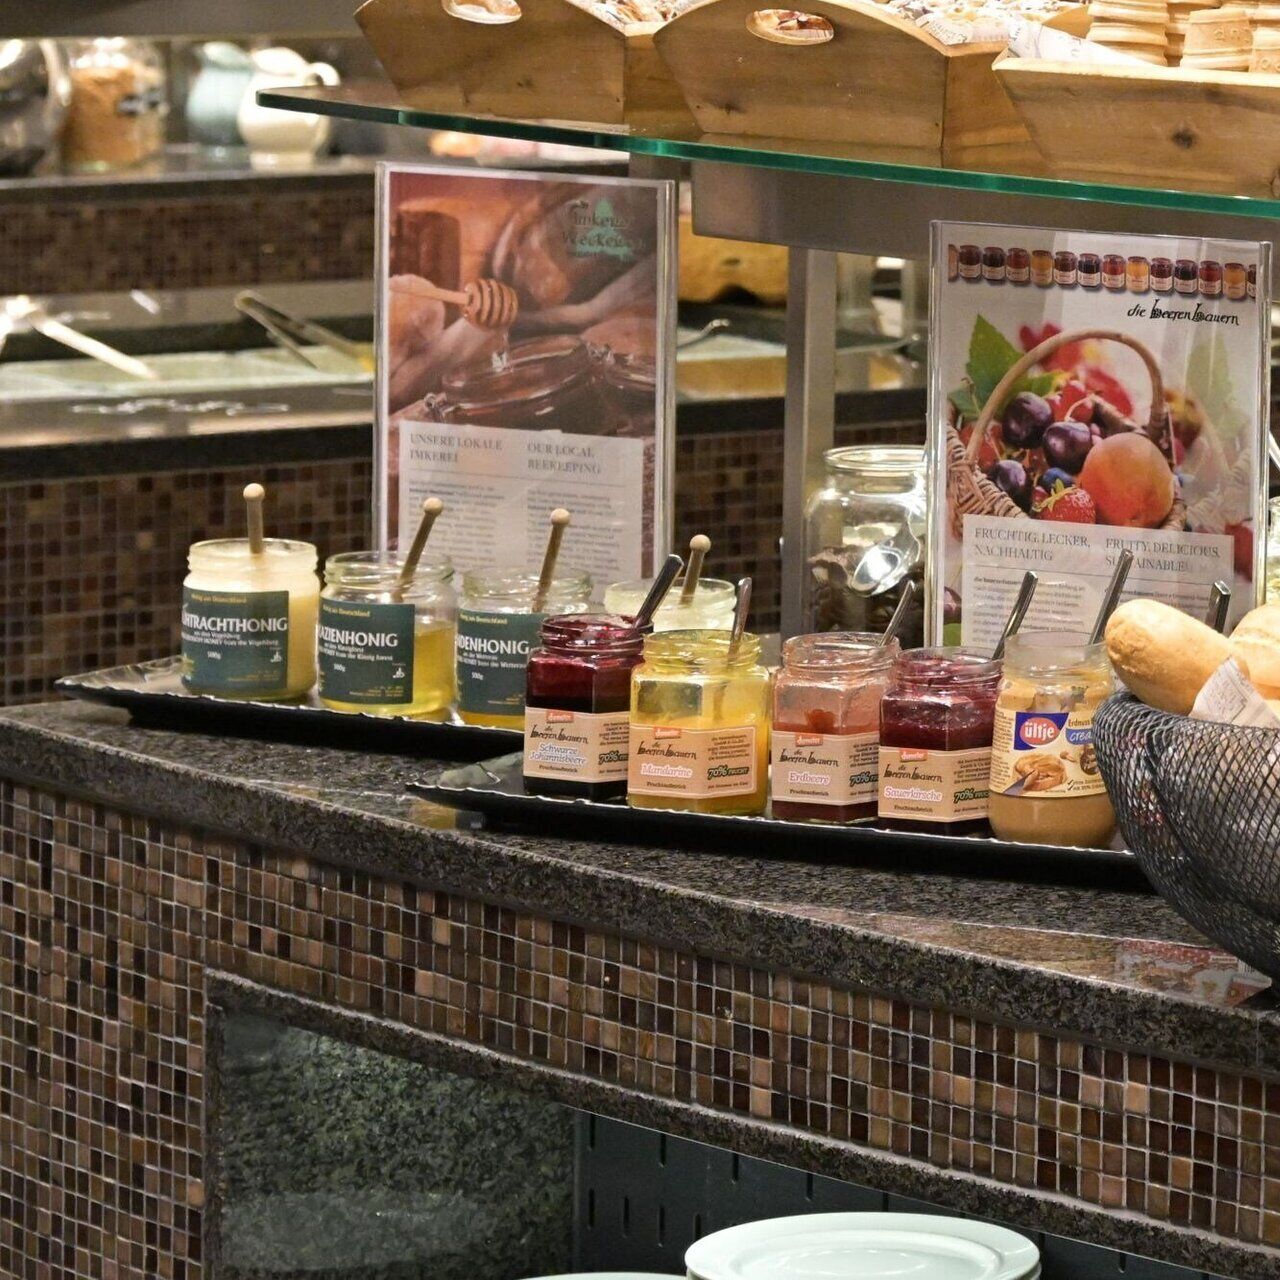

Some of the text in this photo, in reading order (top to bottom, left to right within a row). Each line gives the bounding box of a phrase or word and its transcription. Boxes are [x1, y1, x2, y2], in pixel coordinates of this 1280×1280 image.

[1127, 304, 1146, 317] die
[410, 433, 502, 451] UNSERE LOKALE
[527, 442, 595, 458] OUR LOCAL
[409, 448, 458, 462] IMKEREI
[528, 459, 600, 474] BEEKEEPING
[1042, 532, 1090, 548] LECKER,
[974, 544, 1053, 561] NACHHALTIG
[1024, 720, 1056, 741] ültje
[599, 750, 620, 765] 70%
[641, 763, 692, 778] Mandarine
[707, 764, 728, 781] 70%
[789, 772, 830, 785] Erdbeere
[849, 771, 871, 787] 70%
[884, 786, 942, 801] Sauerkirsche
[953, 788, 974, 804] 70%
